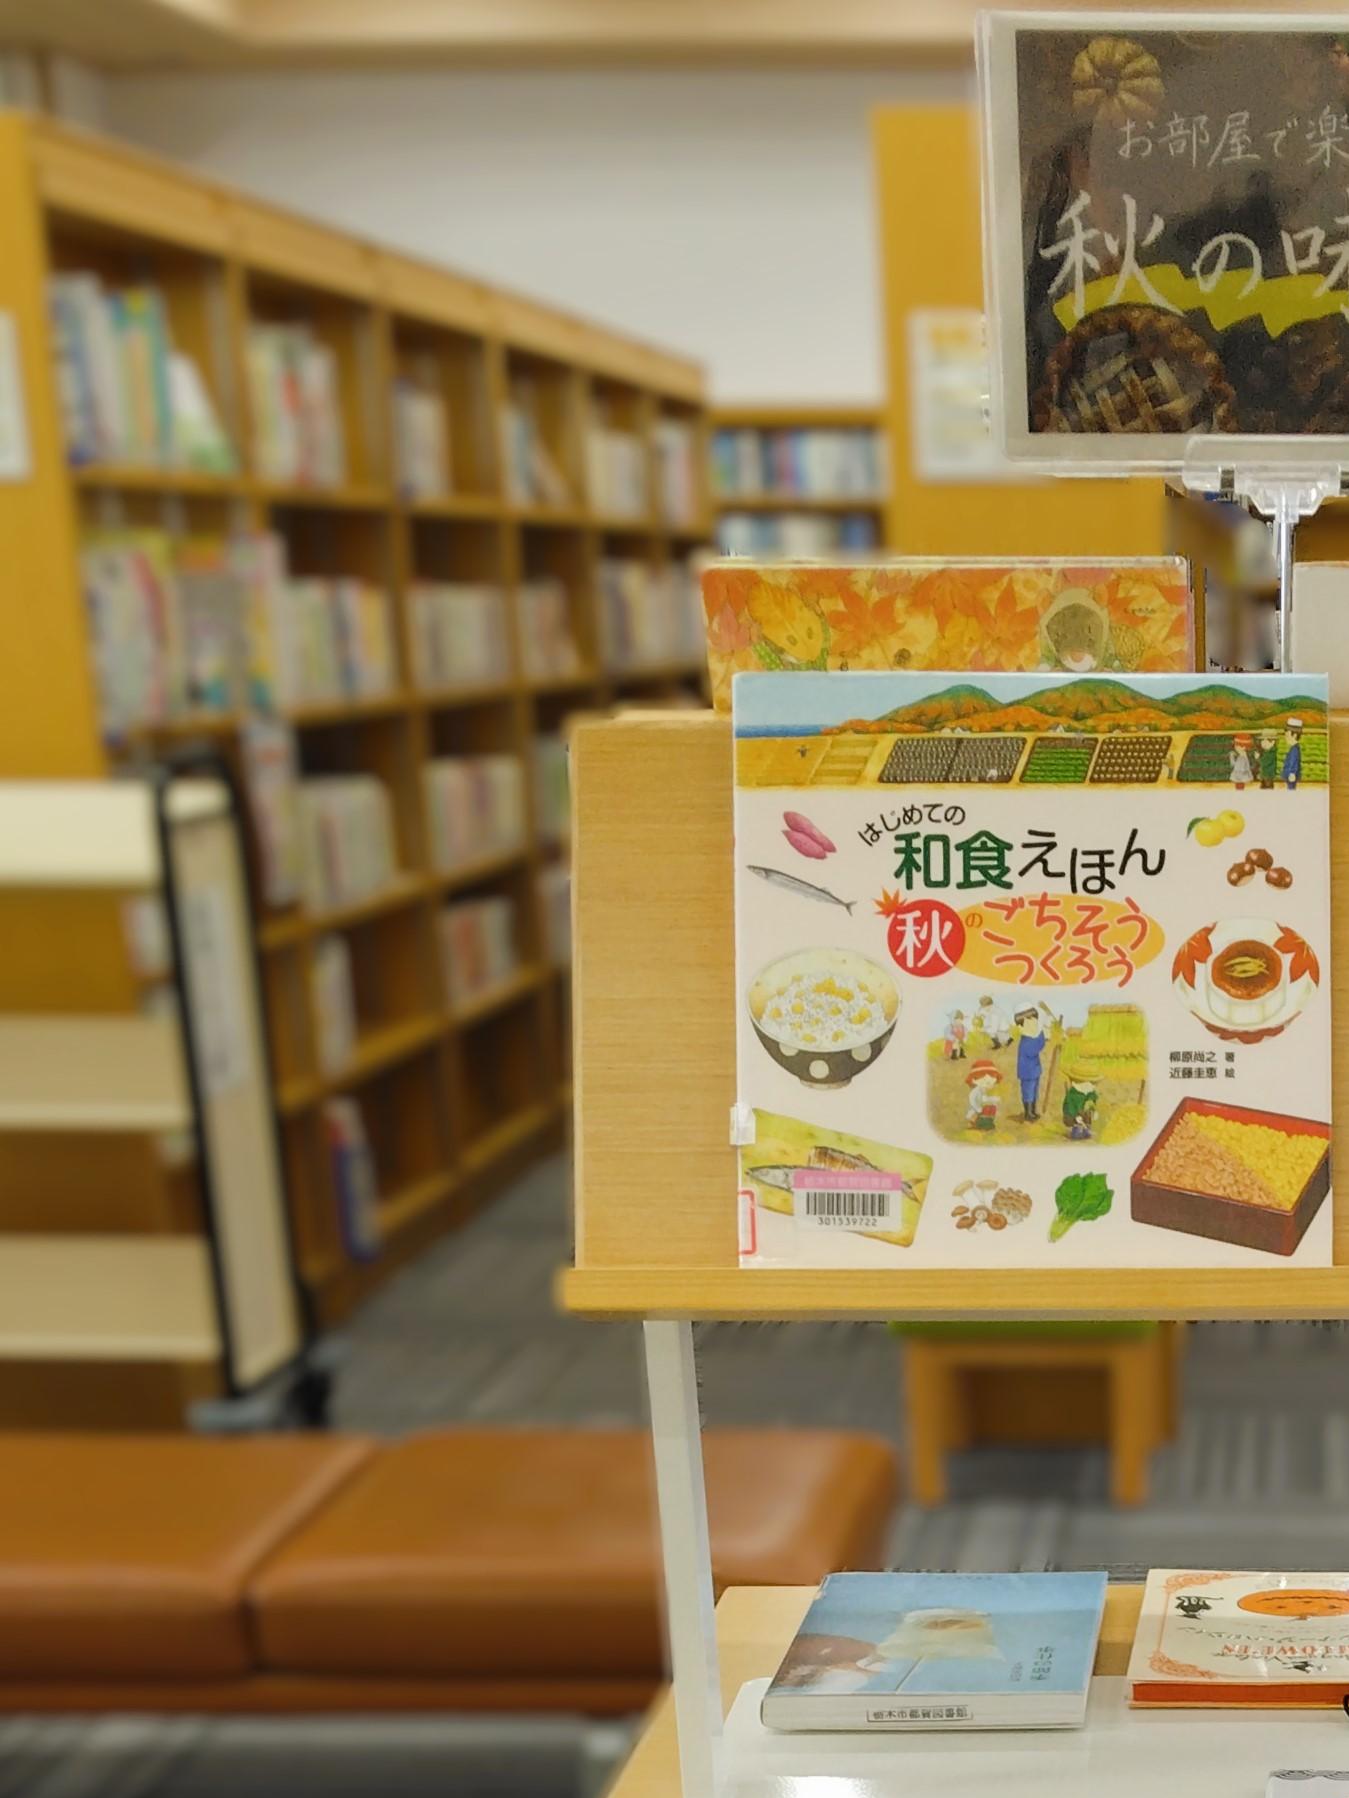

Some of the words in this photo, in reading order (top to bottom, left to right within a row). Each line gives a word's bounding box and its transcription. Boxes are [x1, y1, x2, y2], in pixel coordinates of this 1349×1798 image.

[858, 803, 966, 847] はじめての
[894, 829, 1165, 895] 和食えほん
[994, 945, 1134, 988] つくろう
[818, 1217, 877, 1226] 301539722
